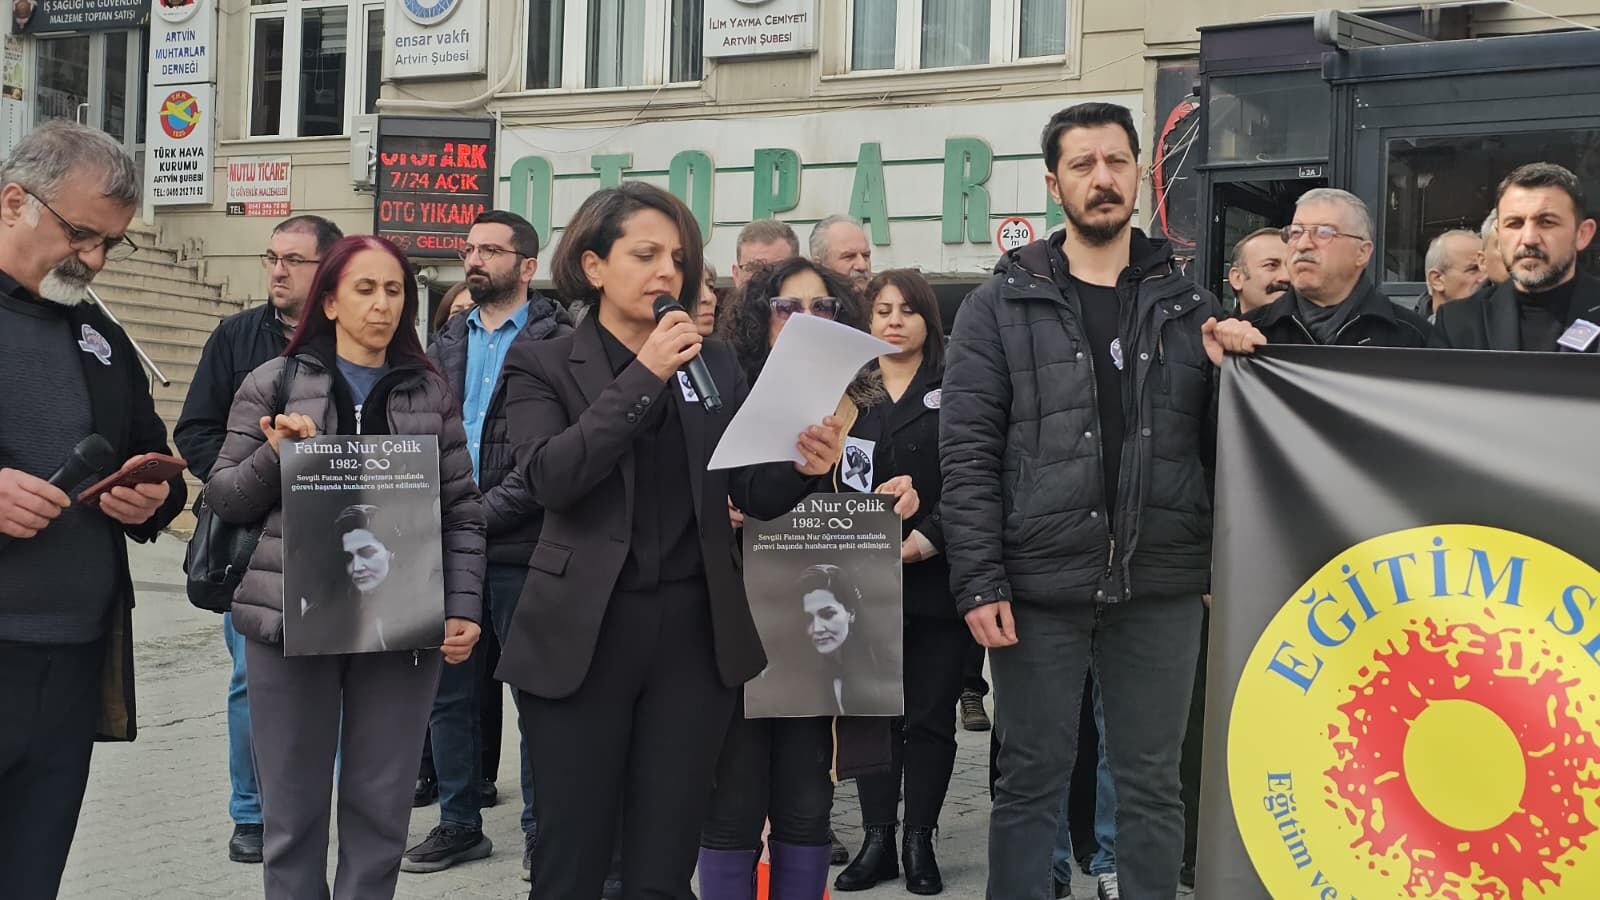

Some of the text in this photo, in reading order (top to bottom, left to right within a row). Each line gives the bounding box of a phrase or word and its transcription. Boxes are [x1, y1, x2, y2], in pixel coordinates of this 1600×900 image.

[50, 9, 136, 24] MALZEME TOPTAN SATIŞI
[729, 17, 762, 29] YAYMA
[765, 11, 807, 26] CEMİYETİ
[165, 27, 196, 42] ARTVİN
[395, 28, 469, 48] ensar vakfı
[723, 32, 792, 47] ARTVİN ŞUBESİ
[155, 46, 205, 60] MUHTARLAR
[395, 49, 469, 66] Artvin Şubesi
[162, 60, 198, 75] DERNEĞİ
[154, 146, 204, 158] TÜRK HAVA
[159, 160, 198, 172] KURUMU
[229, 160, 290, 182] MUTLU TİCARET
[153, 172, 204, 184] ARTVİN ŞUBESİ
[390, 171, 479, 192] 7/24 AÇIK
[1002, 229, 1029, 240] 2,30
[295, 440, 422, 456] Fatma Nur Çelik
[329, 458, 362, 470] 1982-
[811, 500, 841, 512] Nur
[845, 499, 885, 515] Çelik
[792, 517, 825, 529] 1982-
[758, 533, 782, 541] Sevgili
[822, 532, 855, 541] öğretmen
[753, 543, 775, 551] görevi
[776, 543, 803, 551] başında
[839, 542, 856, 550] şehit
[1265, 536, 1530, 695] EĞİTİM
[1263, 770, 1312, 870] Eğitim
